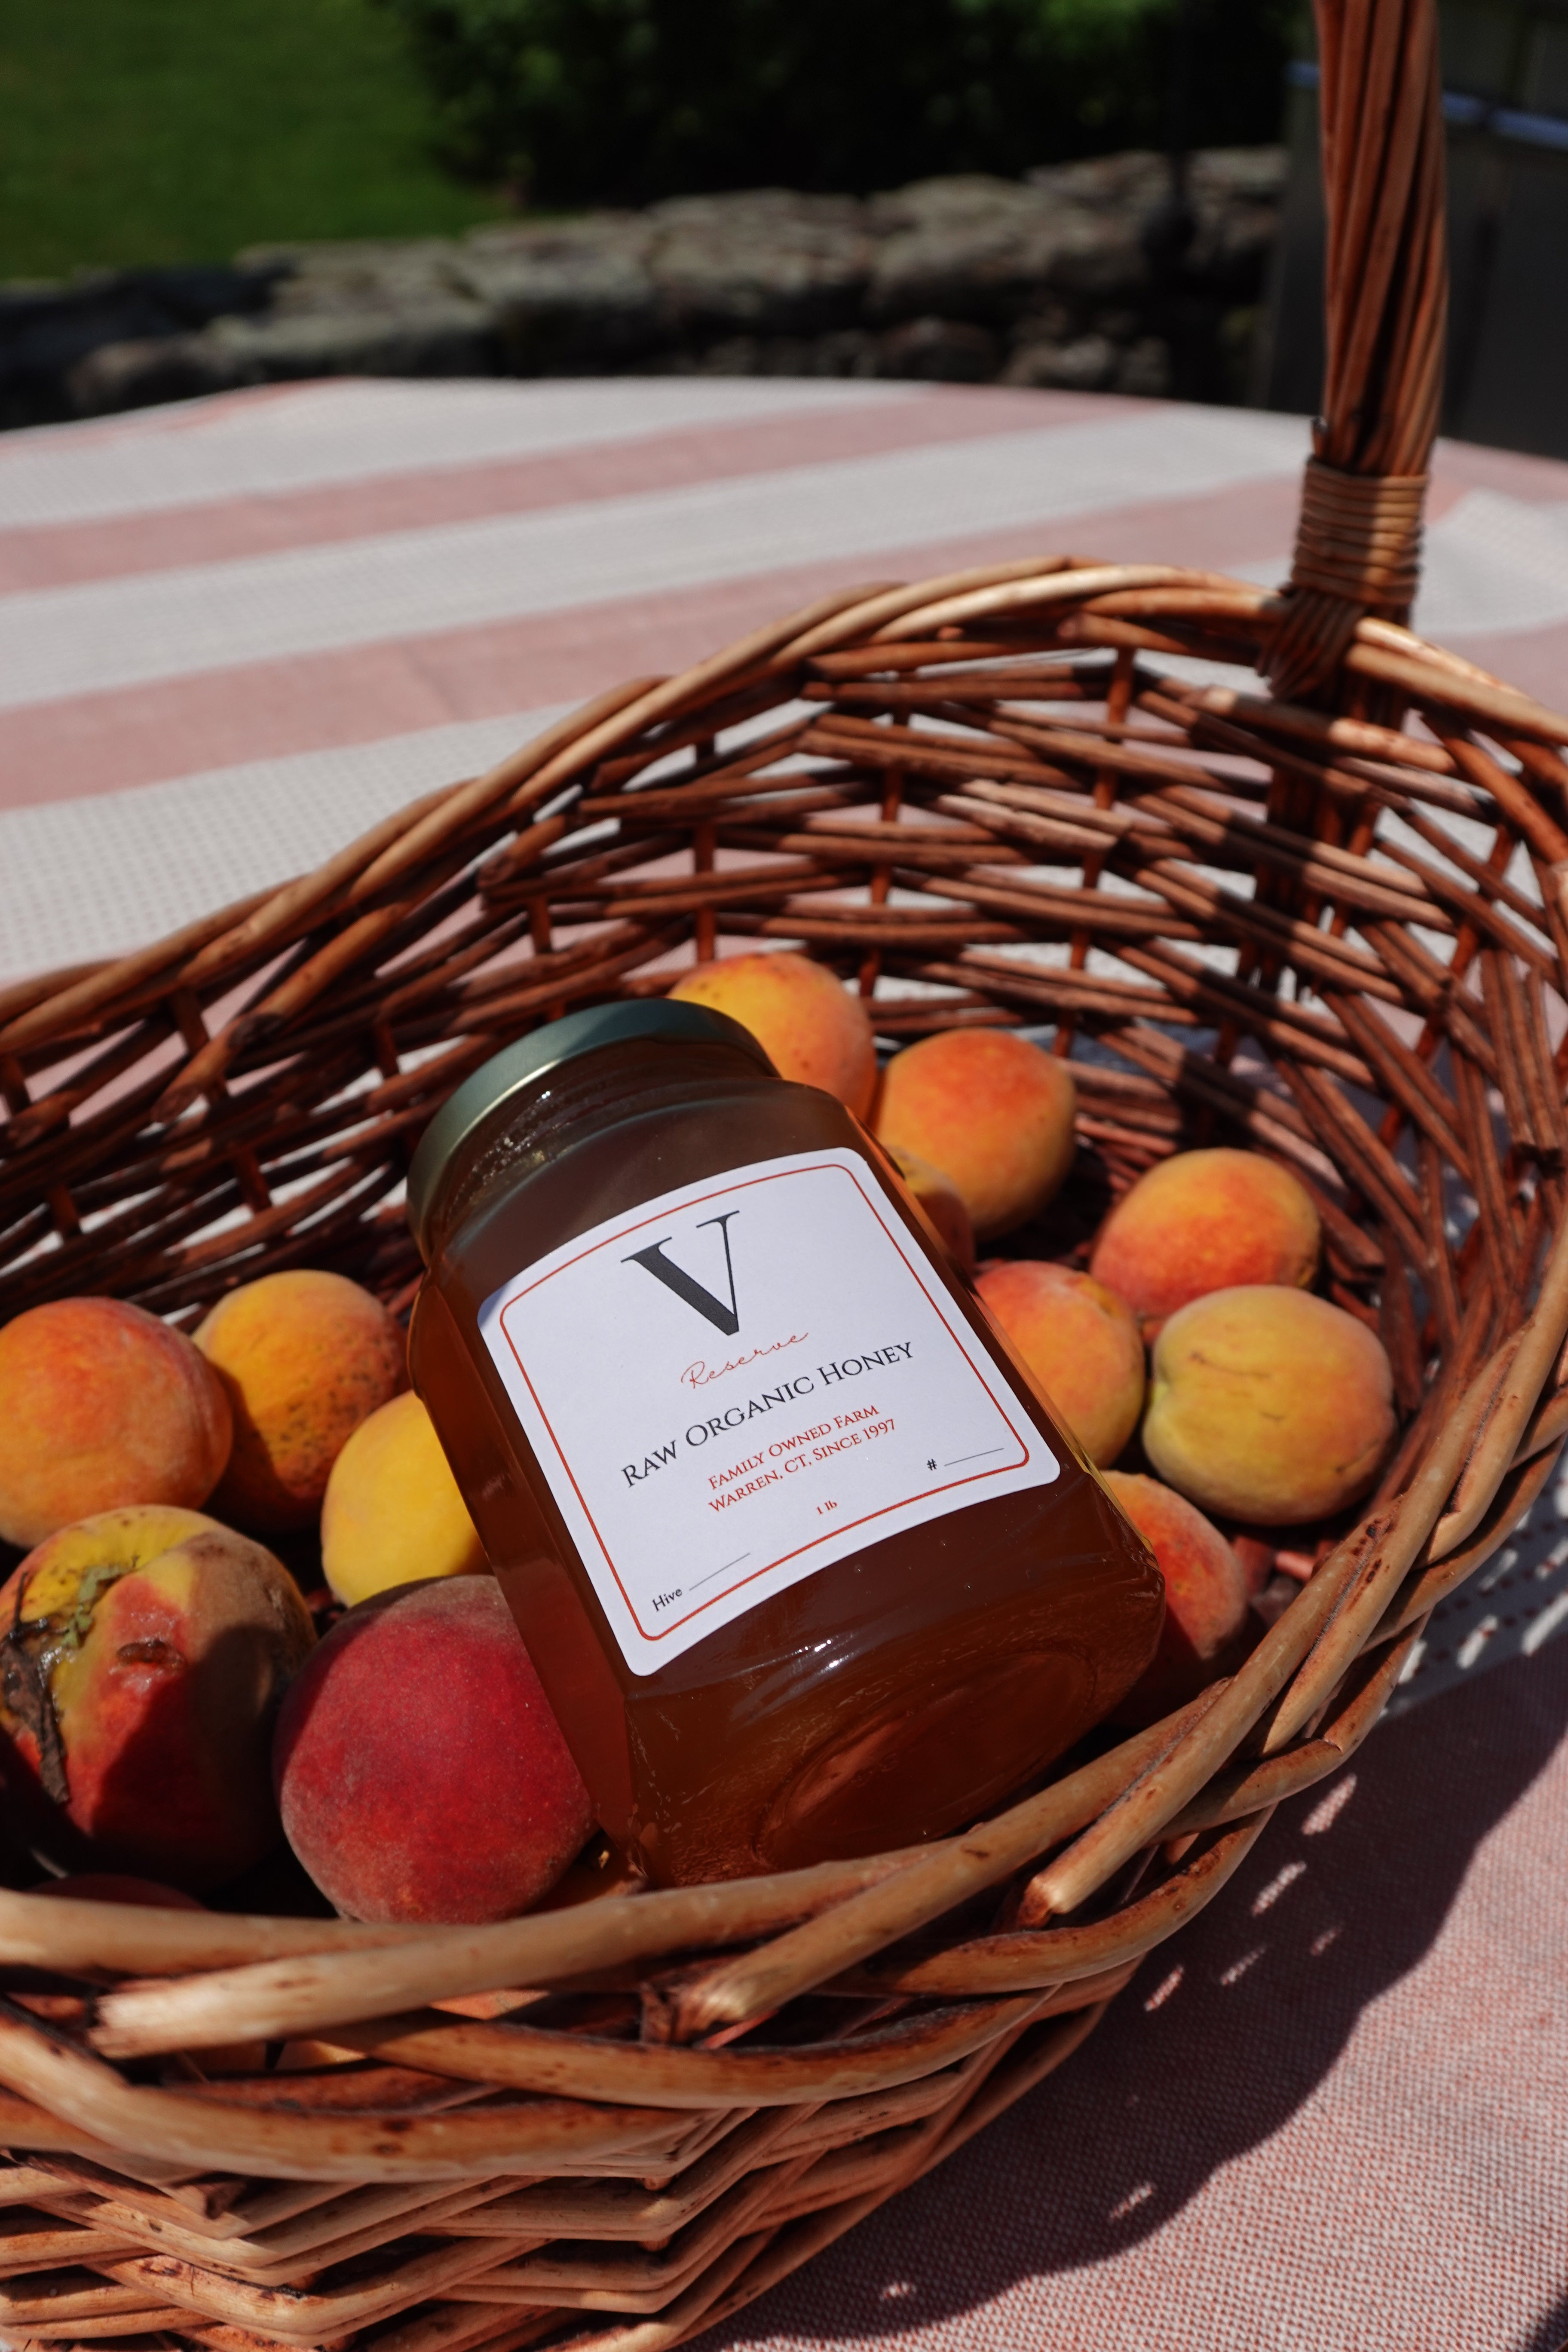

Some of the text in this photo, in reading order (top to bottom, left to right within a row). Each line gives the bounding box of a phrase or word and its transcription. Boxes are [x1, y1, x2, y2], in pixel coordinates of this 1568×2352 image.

[620, 1210, 740, 1337] V
[680, 1332, 808, 1389] Reserve
[621, 1341, 913, 1488] RAW ORGANIC HONEY
[707, 1405, 880, 1491] FAMILY OWNED FARM
[812, 1433, 862, 1461] SINCE
[862, 1418, 896, 1440] 1997
[652, 1588, 683, 1612] Hive
